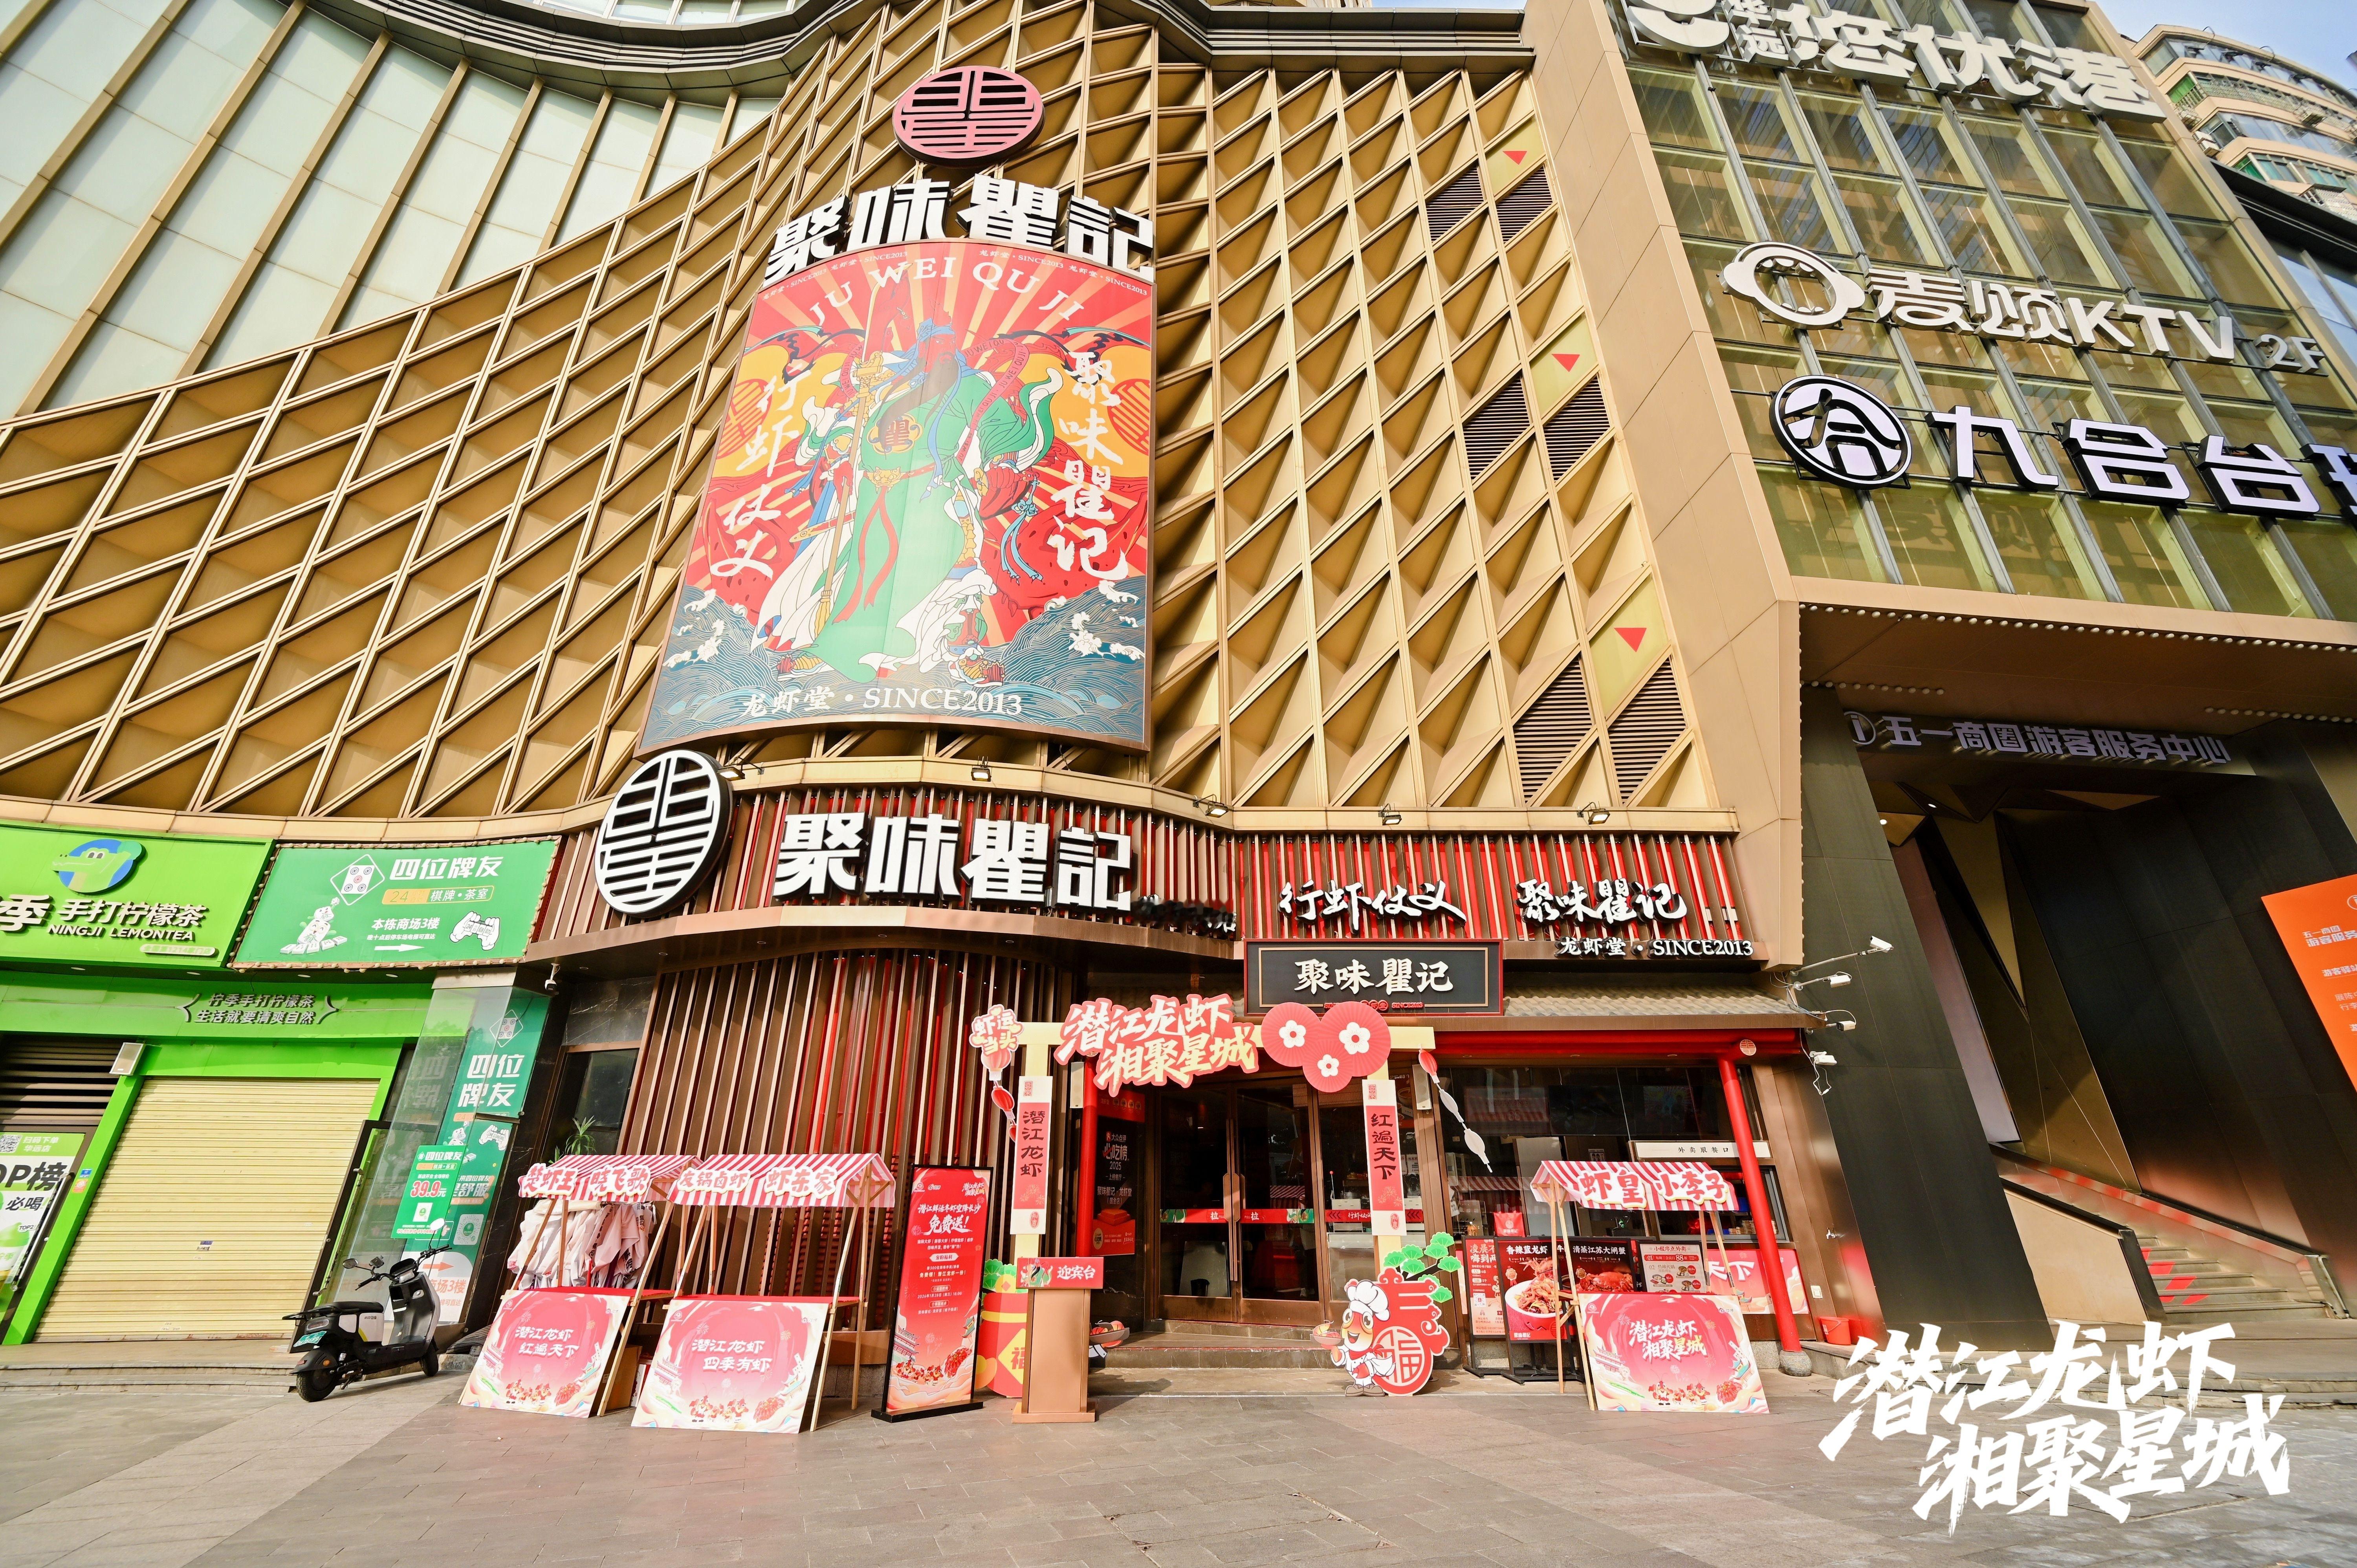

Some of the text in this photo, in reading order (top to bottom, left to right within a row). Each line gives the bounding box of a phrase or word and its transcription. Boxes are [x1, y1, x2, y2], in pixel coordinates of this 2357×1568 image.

[763, 173, 1154, 284] 聚味瞿記
[809, 256, 1085, 327] JU WEI QU JI
[1865, 268, 2325, 374] 麦颂KTV 2F
[744, 686, 1022, 716] 龙虾堂 SINCE2013
[1882, 716, 2232, 764] 五一商圈游客服务中心
[389, 856, 504, 881] 四位牌友
[773, 811, 1131, 910] 聚味瞿記
[390, 890, 409, 903] 24
[1518, 878, 1687, 925] 聚味瞿记
[57, 899, 207, 927] 手打柠檬茶
[371, 917, 440, 931] 本栋商场3楼
[48, 924, 194, 941] NINGJI LEMONTEA
[2302, 925, 2341, 939] 五一商圈
[1560, 937, 1754, 956] 龙虾堂 SINCE2013
[1294, 958, 1453, 995] 聚味瞿记
[209, 993, 315, 1008] 柠季手打柠檬茶
[195, 1010, 315, 1024] 生活就要清爽自然
[1058, 997, 1230, 1061] 潜江龙虾
[467, 1054, 525, 1079] 四位
[1096, 1027, 1255, 1094] 湘聚星城
[458, 1083, 516, 1107] 牌友
[1020, 1111, 1045, 1177] 潜江龙虾
[1111, 1133, 1126, 1142] 大众点评
[1371, 1114, 1397, 1180] 红遍天下
[425, 1152, 463, 1161] 四位牌友
[1102, 1143, 1128, 1161] 必吃榜
[1109, 1161, 1122, 1171] 2025
[524, 1165, 575, 1192] 楚虾王
[590, 1168, 648, 1192] 晓飞歌
[679, 1171, 748, 1189] 友锅卤虾
[1579, 1169, 1643, 1203] 虾皇
[1654, 1171, 1725, 1200] 小李子
[924, 1214, 973, 1235] 免费送!
[1210, 1211, 1218, 1221] 拉
[1251, 1211, 1259, 1221] 拉
[1506, 1245, 1548, 1255] 香辣蓝龙虾
[1573, 1246, 1626, 1255] 清蒸江苏大闸蟹
[1057, 1265, 1096, 1280] 迎宾台
[515, 1326, 574, 1342] 潜江龙虾
[1629, 1320, 1697, 1346] 潜江龙虾
[519, 1342, 580, 1359] 红遍天下
[692, 1339, 765, 1354] 潜江龙虾
[1642, 1335, 1707, 1364] 湘聚星城
[703, 1356, 773, 1374] 四季有虾
